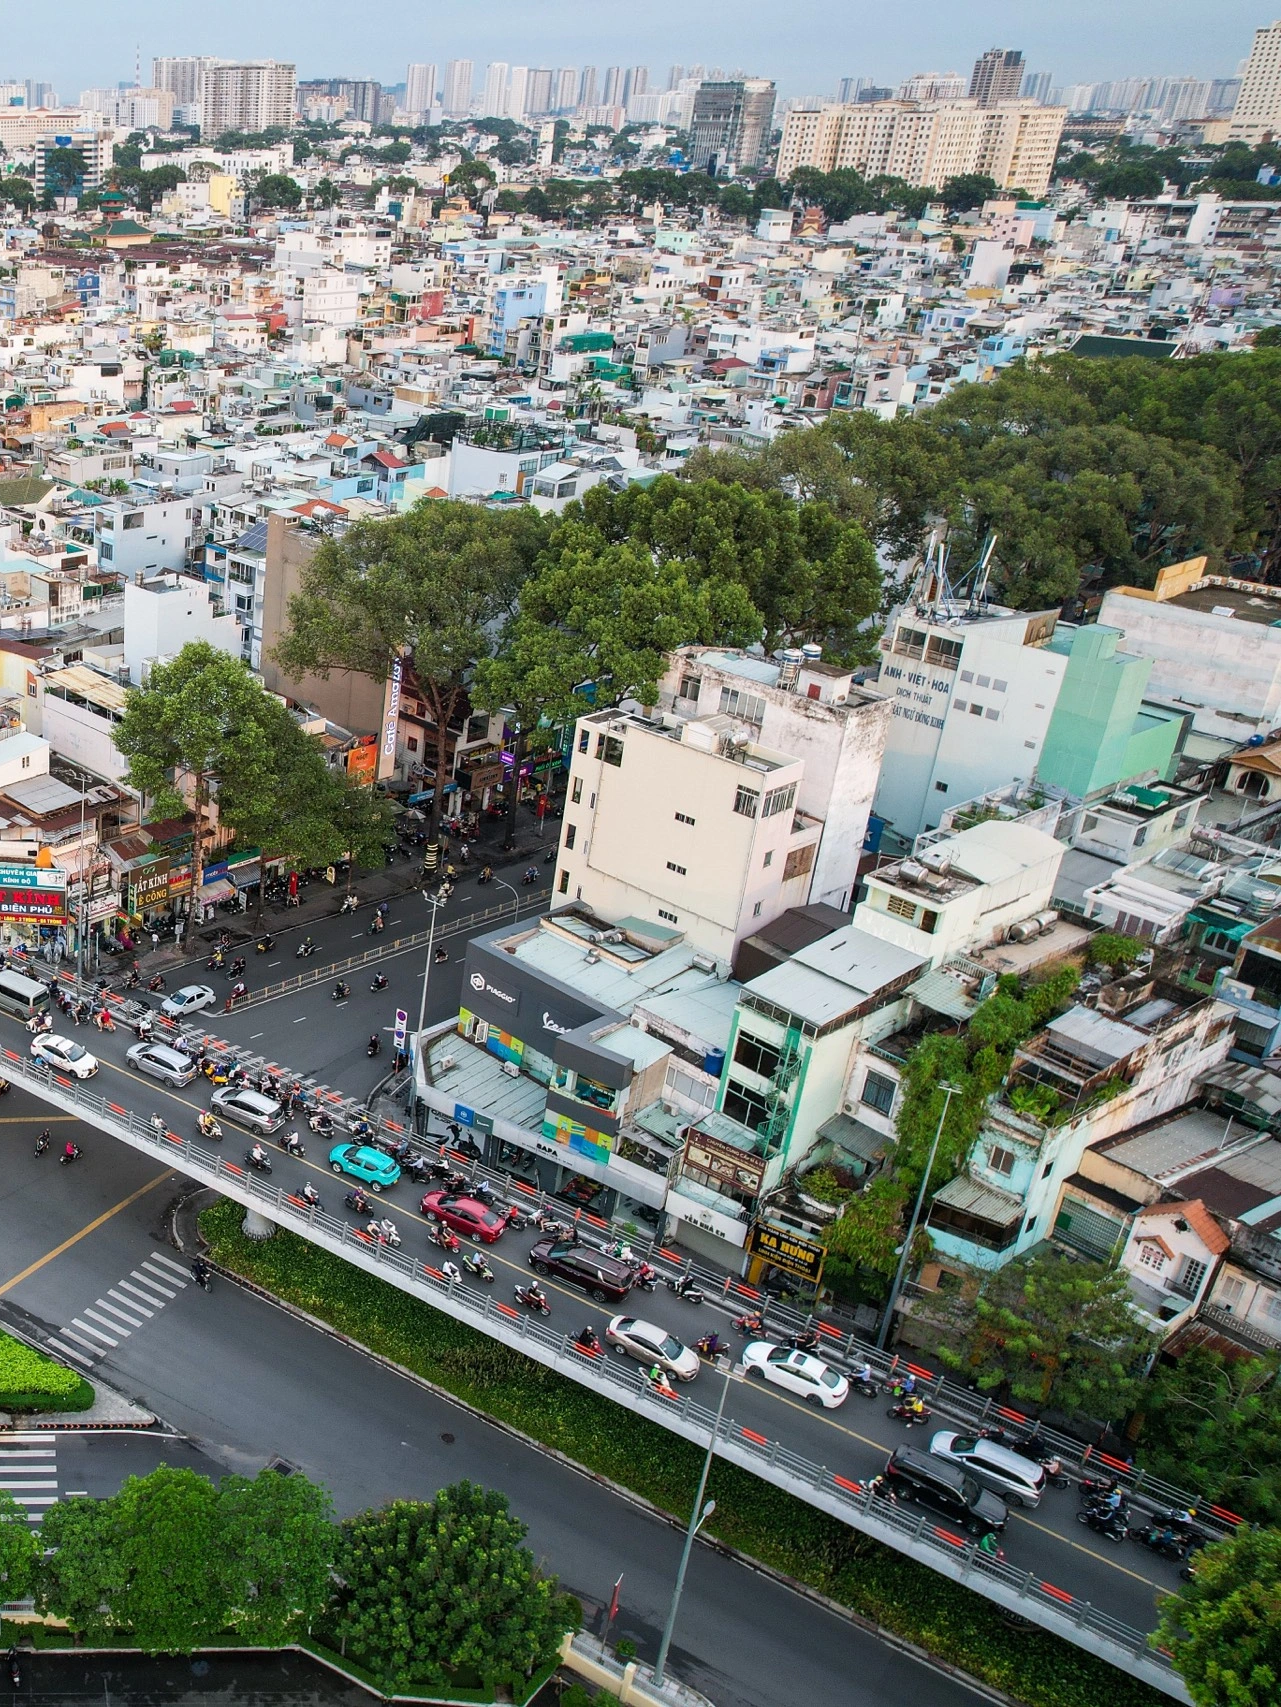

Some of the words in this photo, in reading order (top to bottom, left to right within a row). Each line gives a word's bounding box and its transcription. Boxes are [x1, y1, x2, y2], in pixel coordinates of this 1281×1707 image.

[884, 666, 902, 679] ANH
[908, 672, 926, 688] VIỆT
[931, 679, 950, 693] HOA
[385, 721, 396, 754] Café
[3, 876, 19, 884] KÍNH
[148, 874, 168, 888] KÍNH
[13, 889, 60, 905] KÍNH
[146, 889, 166, 902] CÔNG
[1, 903, 26, 912] BIÊN
[30, 905, 52, 914] PHỦ
[486, 985, 514, 1003] PIAGGIO
[760, 1232, 777, 1248] KA
